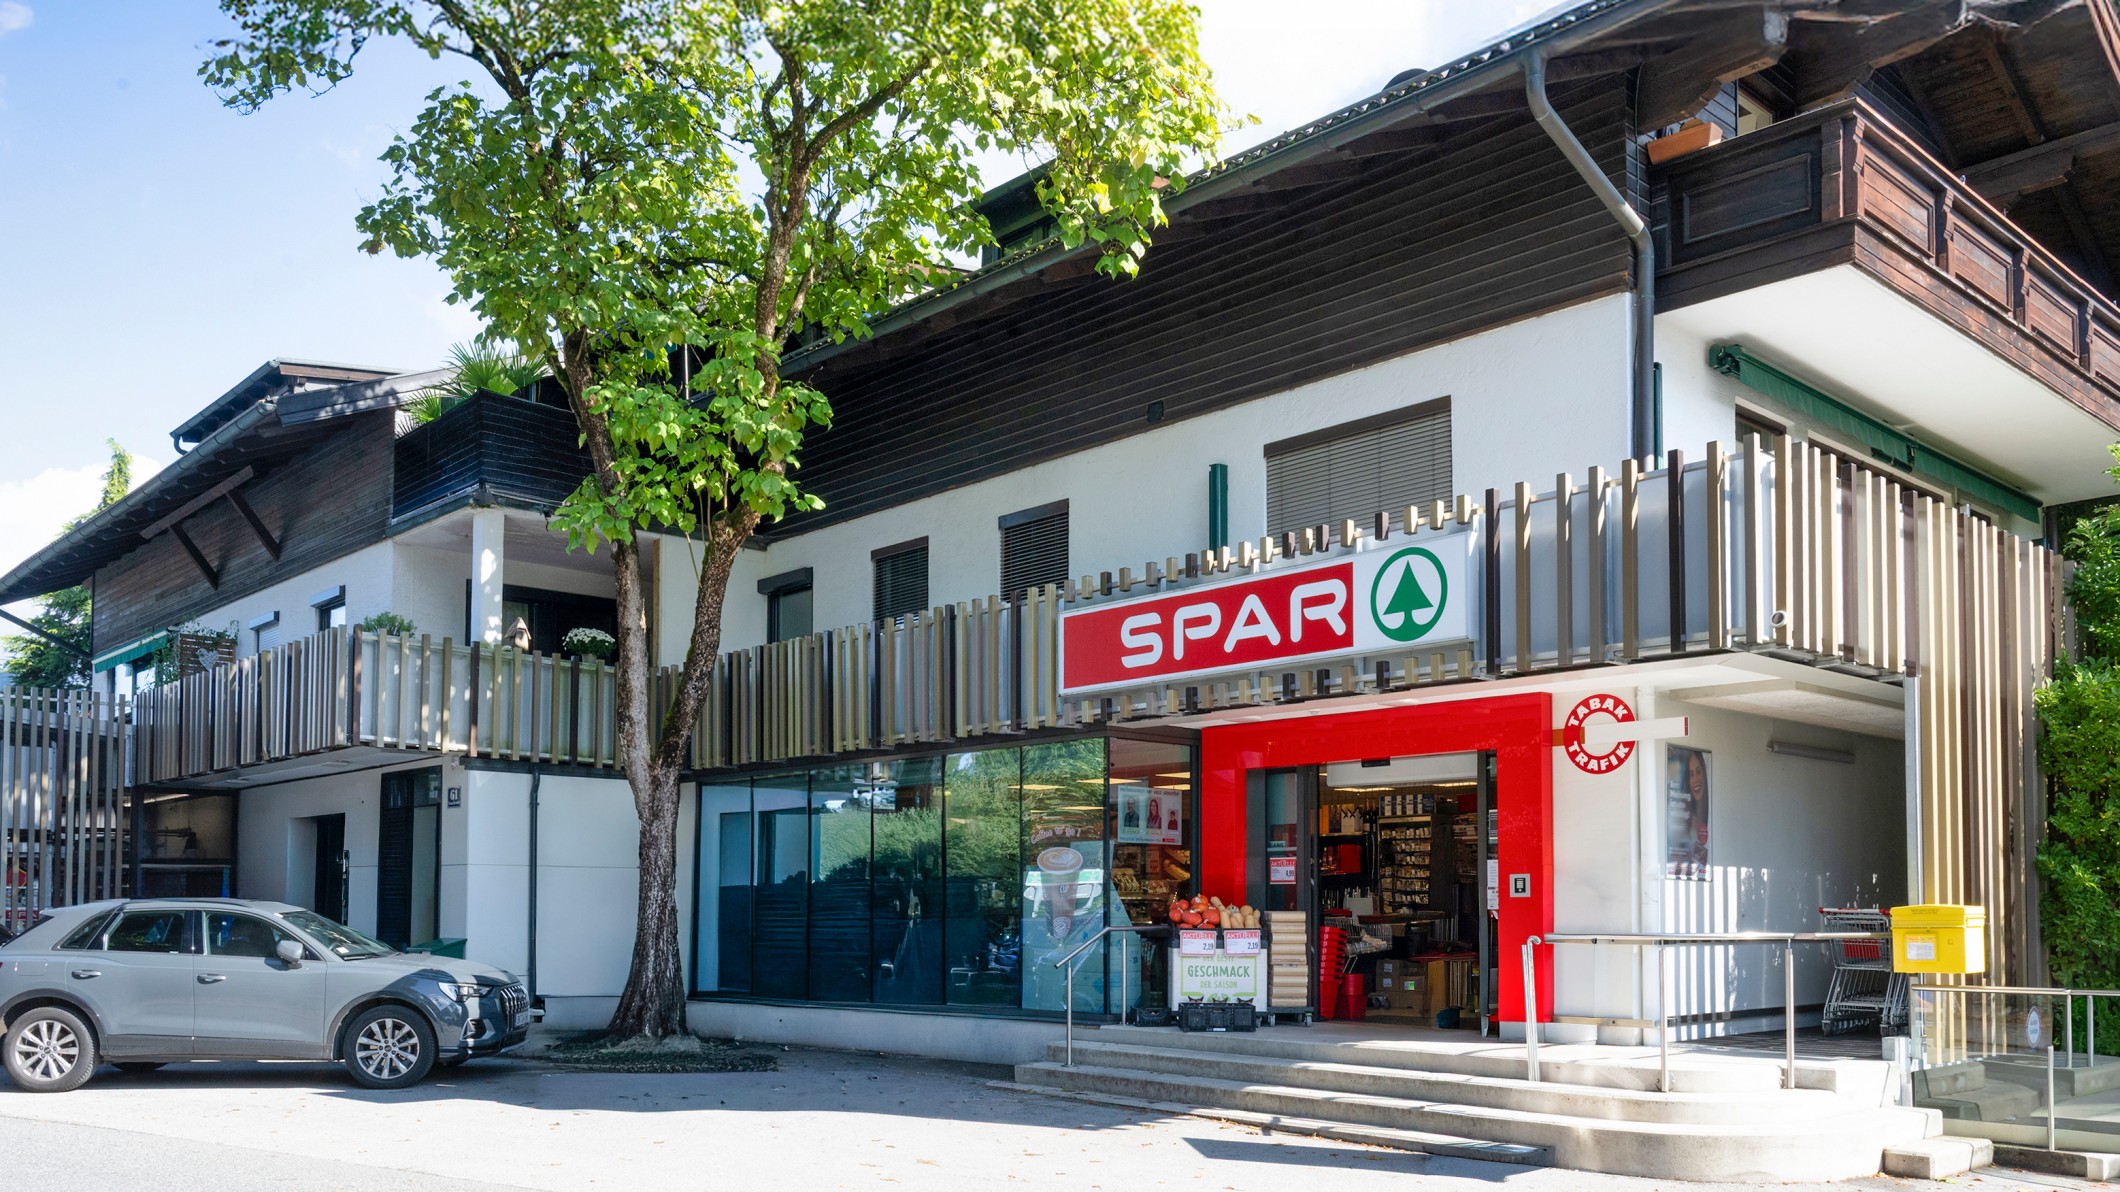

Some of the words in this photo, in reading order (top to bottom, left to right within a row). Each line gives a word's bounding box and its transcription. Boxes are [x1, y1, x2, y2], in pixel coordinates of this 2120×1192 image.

[1120, 578, 1348, 669] SPAR
[1568, 697, 1629, 727] TABAK
[1568, 741, 1630, 771] TRAFIK
[450, 789, 458, 801] 61
[1202, 943, 1214, 951] 2,19
[1187, 965, 1250, 977] GESCHMACK
[1200, 981, 1212, 989] DER
[1214, 980, 1238, 989] SAISON
